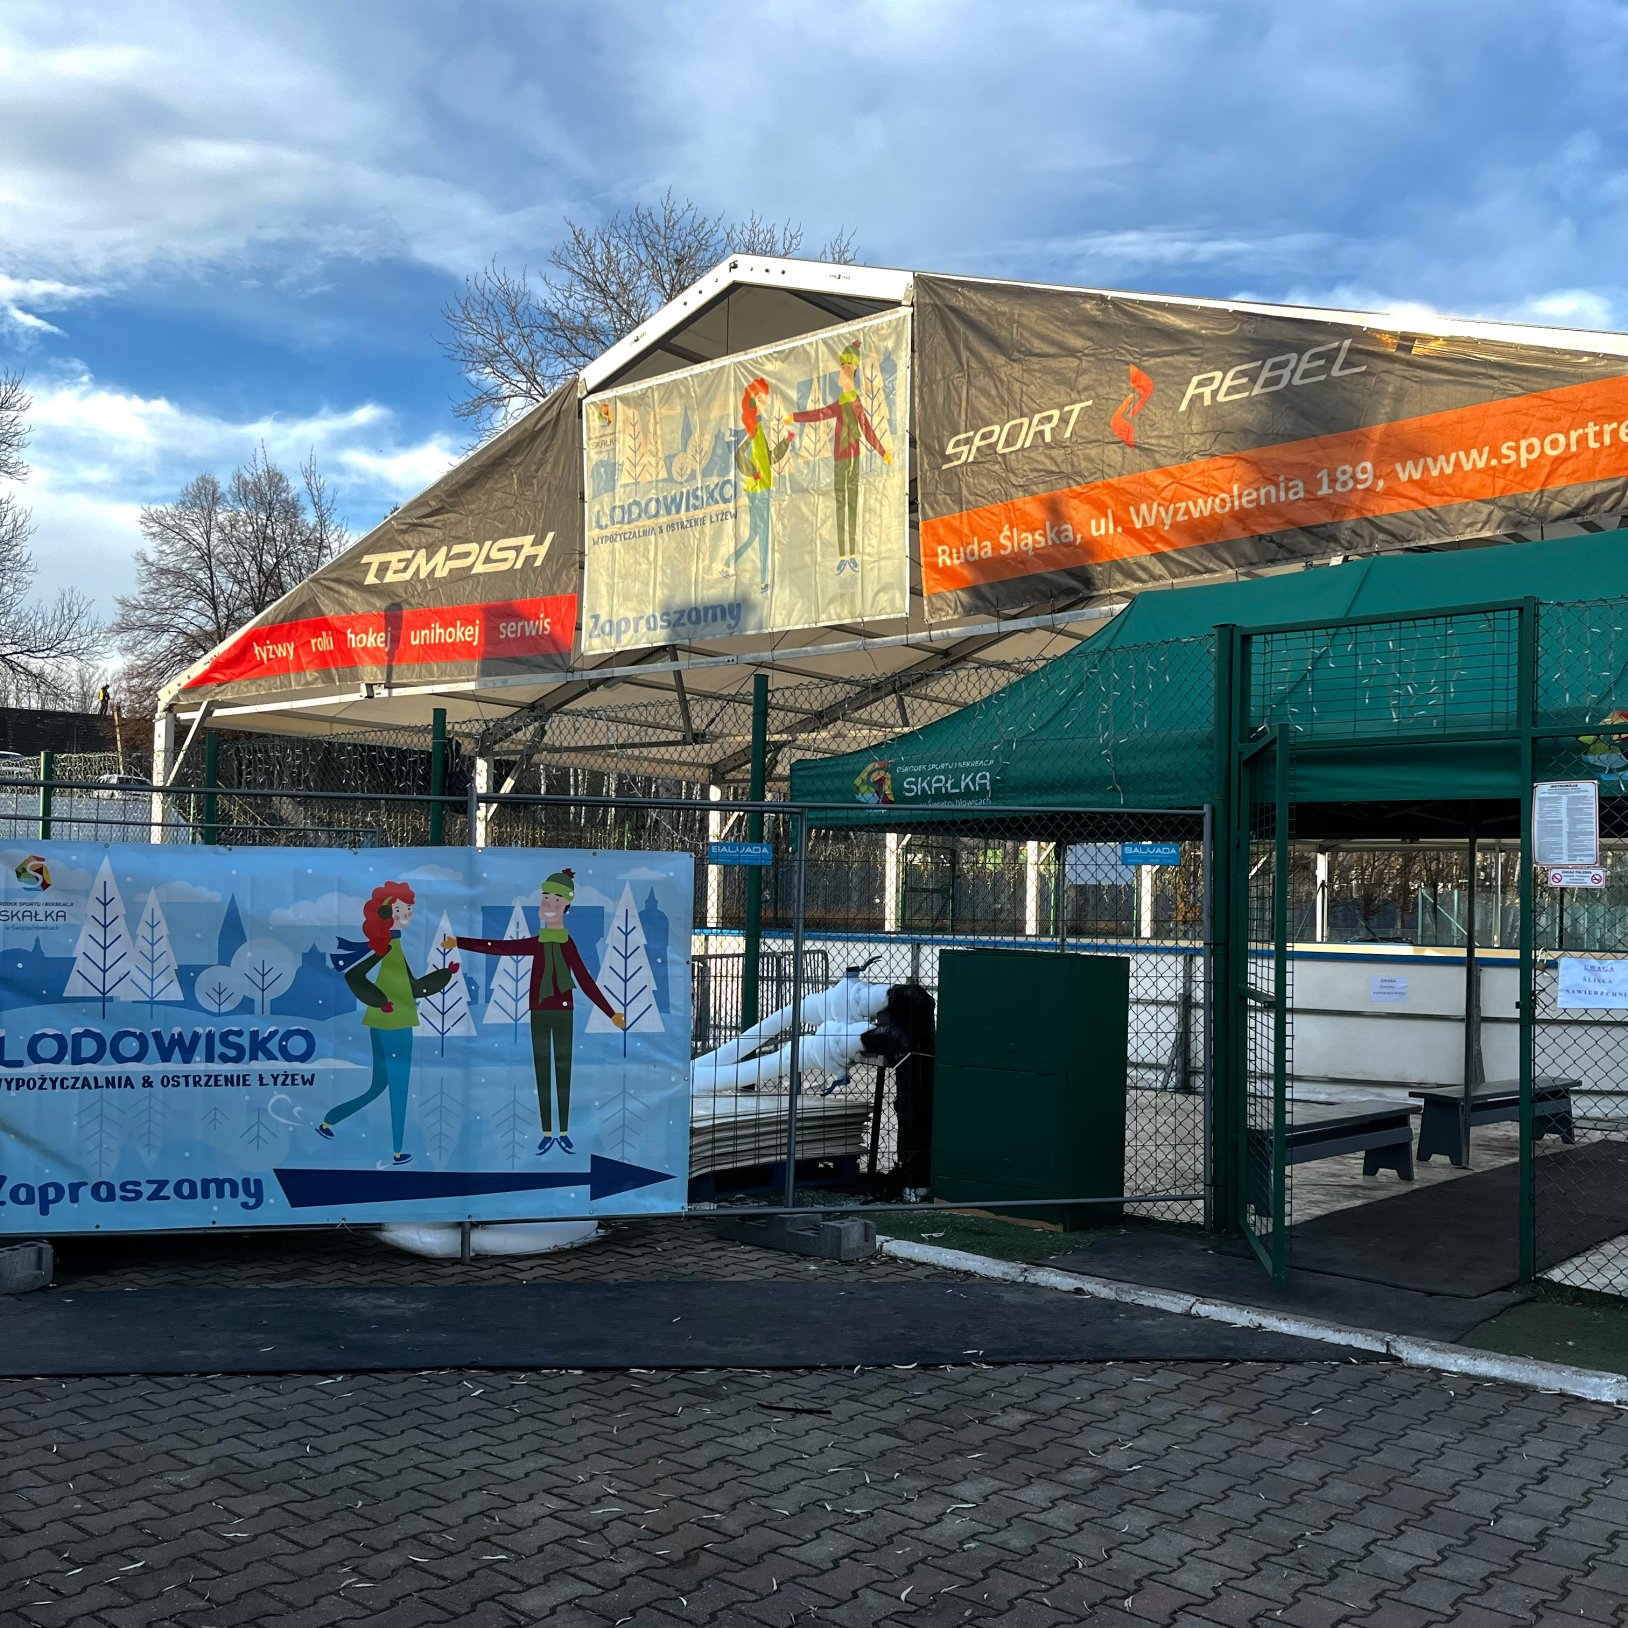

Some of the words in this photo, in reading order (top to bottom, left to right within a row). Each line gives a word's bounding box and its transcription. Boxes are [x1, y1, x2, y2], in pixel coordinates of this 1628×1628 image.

[941, 400, 1093, 470] SPORT
[1178, 338, 1367, 412] REBEL
[595, 478, 738, 530] LODOWISKO
[937, 539, 992, 568] Ruda
[1000, 520, 1082, 557] Śląska,
[1090, 514, 1122, 538] ul.
[1129, 474, 1304, 531] Wyzwolenia
[1316, 461, 1385, 496] 189,
[1395, 419, 1628, 482] www.sportre
[592, 528, 656, 546] WYPOŻYCZALNIA
[658, 525, 664, 534] &
[666, 515, 706, 533] OSTRZENIE
[360, 531, 555, 585] TEMPISH
[253, 640, 294, 664] łyżwy
[310, 630, 334, 652] rolki
[347, 627, 391, 652] hokej
[410, 619, 480, 646] unihokej
[499, 613, 551, 639] serwis
[588, 602, 742, 643] Zapraszamy
[903, 771, 990, 797] SKAŁKA
[711, 845, 769, 854] SALVADA
[1124, 846, 1177, 855] SALVADA
[0, 910, 67, 922] SKAŁKA
[0, 1026, 316, 1068] LODOWISKO
[141, 1074, 154, 1088] &
[160, 1073, 251, 1088] OSTRZENIE
[258, 1070, 316, 1087] ŁYŻEW
